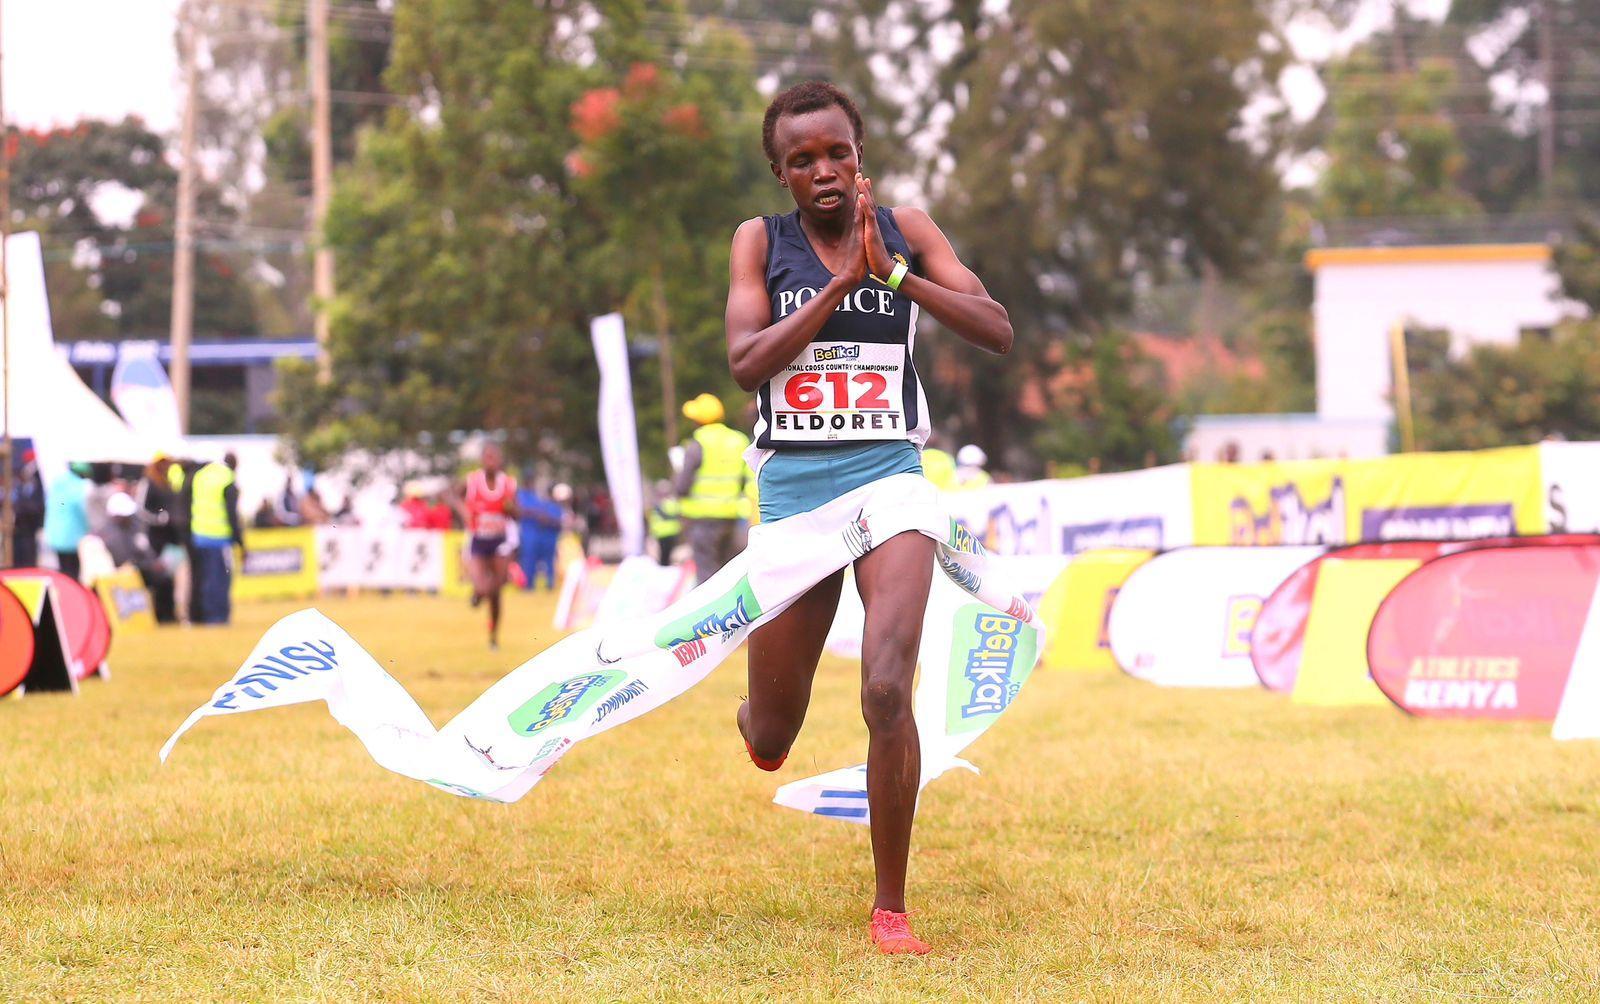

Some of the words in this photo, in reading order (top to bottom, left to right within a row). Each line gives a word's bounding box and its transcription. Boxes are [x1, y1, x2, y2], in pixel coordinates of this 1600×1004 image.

[779, 287, 895, 317] POICE
[813, 345, 860, 362] Betika!
[853, 363, 899, 372] CHAMPIONSHIP
[784, 372, 890, 410] 612
[776, 414, 899, 430] ELDORET
[672, 639, 706, 667] KENYA
[1409, 657, 1519, 678] ATHLETICS
[1404, 681, 1518, 708] KENYA
